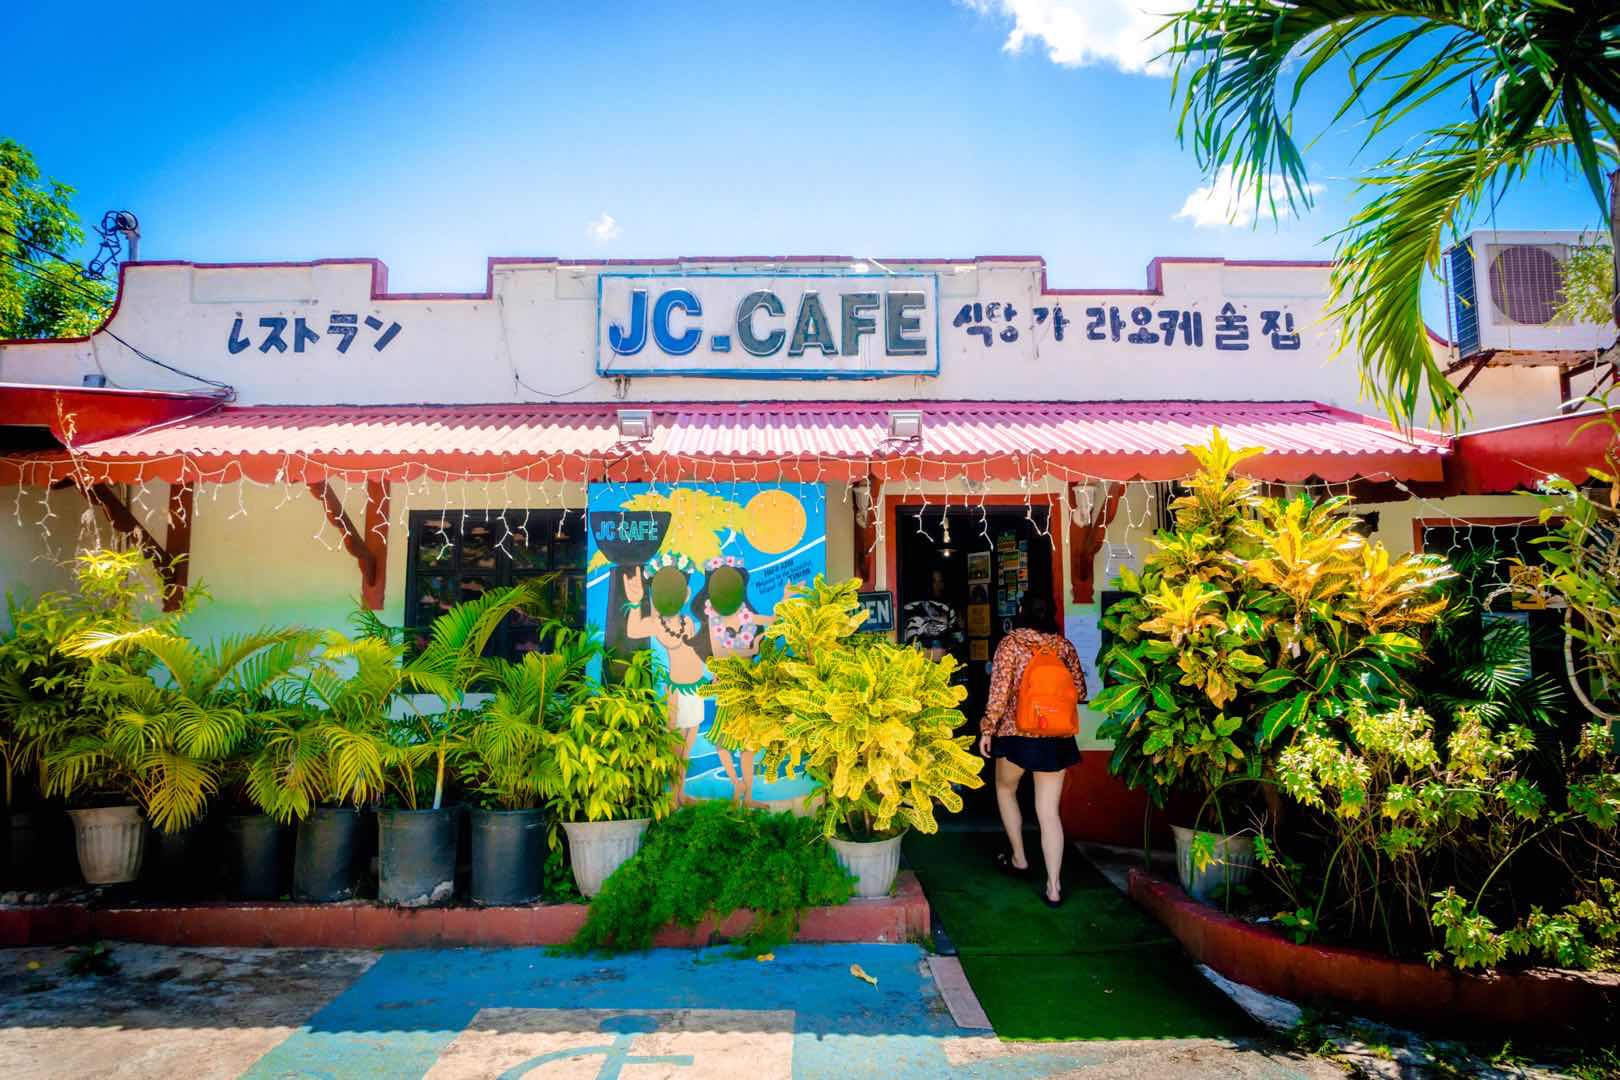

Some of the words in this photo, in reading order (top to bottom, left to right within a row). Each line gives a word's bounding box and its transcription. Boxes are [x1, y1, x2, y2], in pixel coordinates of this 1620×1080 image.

[228, 314, 402, 353] レストラン
[618, 520, 658, 541] CAFE
